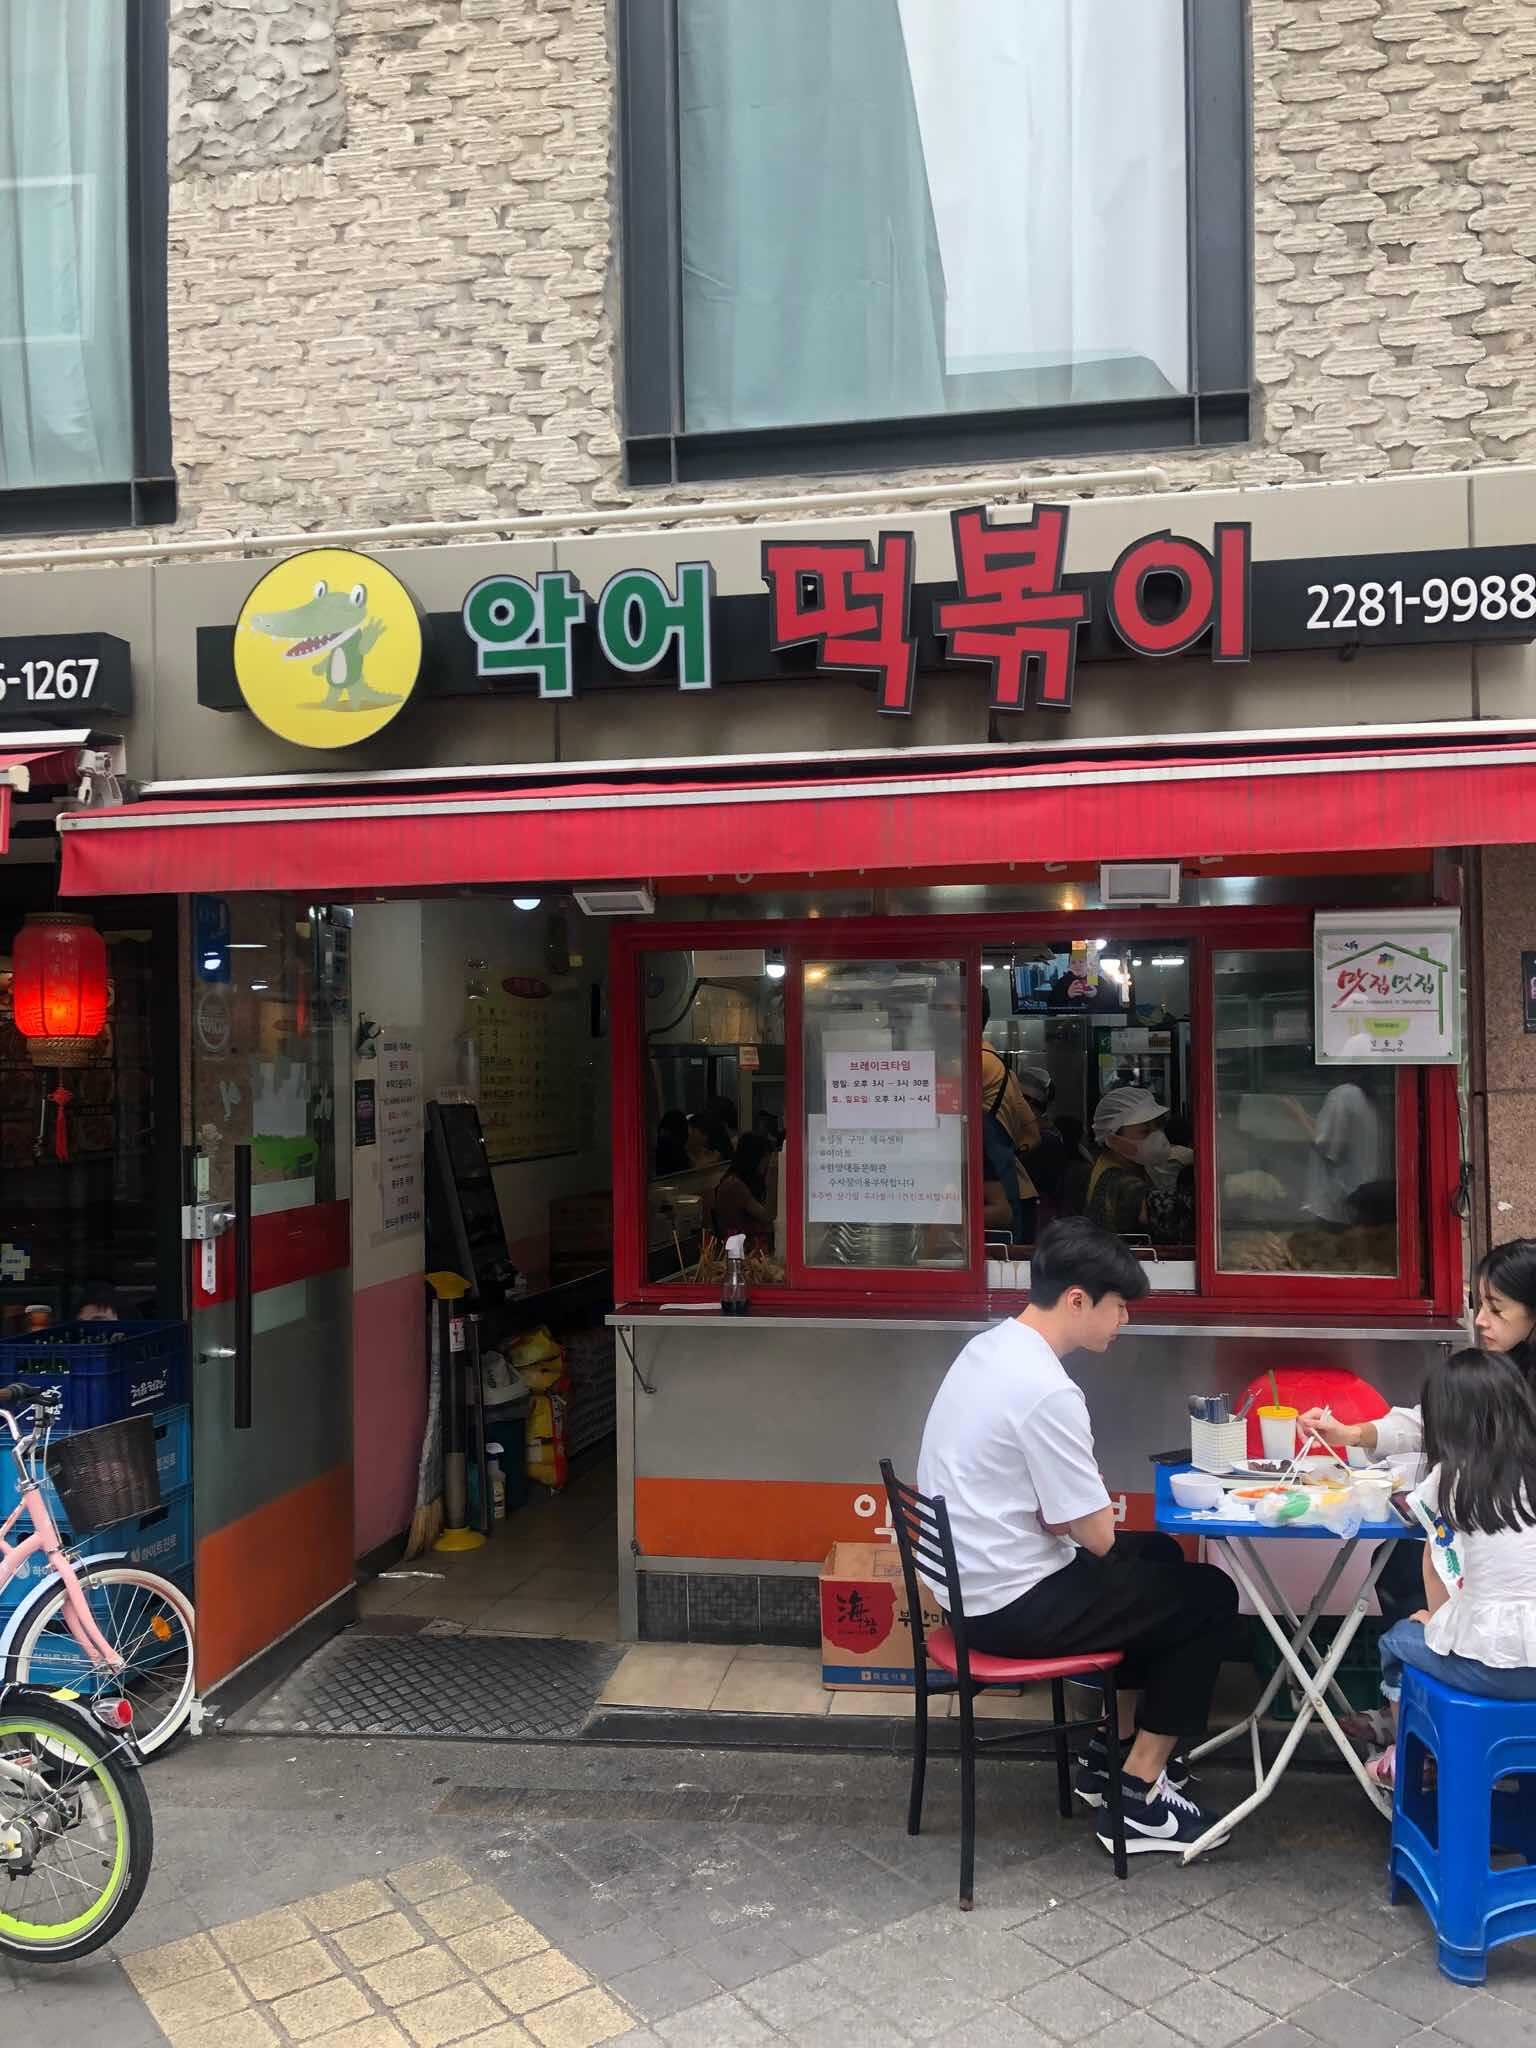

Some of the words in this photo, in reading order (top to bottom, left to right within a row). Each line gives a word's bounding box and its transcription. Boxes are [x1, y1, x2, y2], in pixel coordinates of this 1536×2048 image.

[1306, 573, 1536, 630] 2281-9988
[462, 560, 717, 700] 악어
[761, 504, 1252, 714] 떡볶이
[849, 1060, 912, 1072] 브레이크타임
[853, 1079, 868, 1088] 오후
[872, 1079, 885, 1088] 3시
[913, 1079, 929, 1088] 30분
[874, 1095, 889, 1104] 오후
[894, 1095, 906, 1104] 3시
[917, 1095, 931, 1104] 4시
